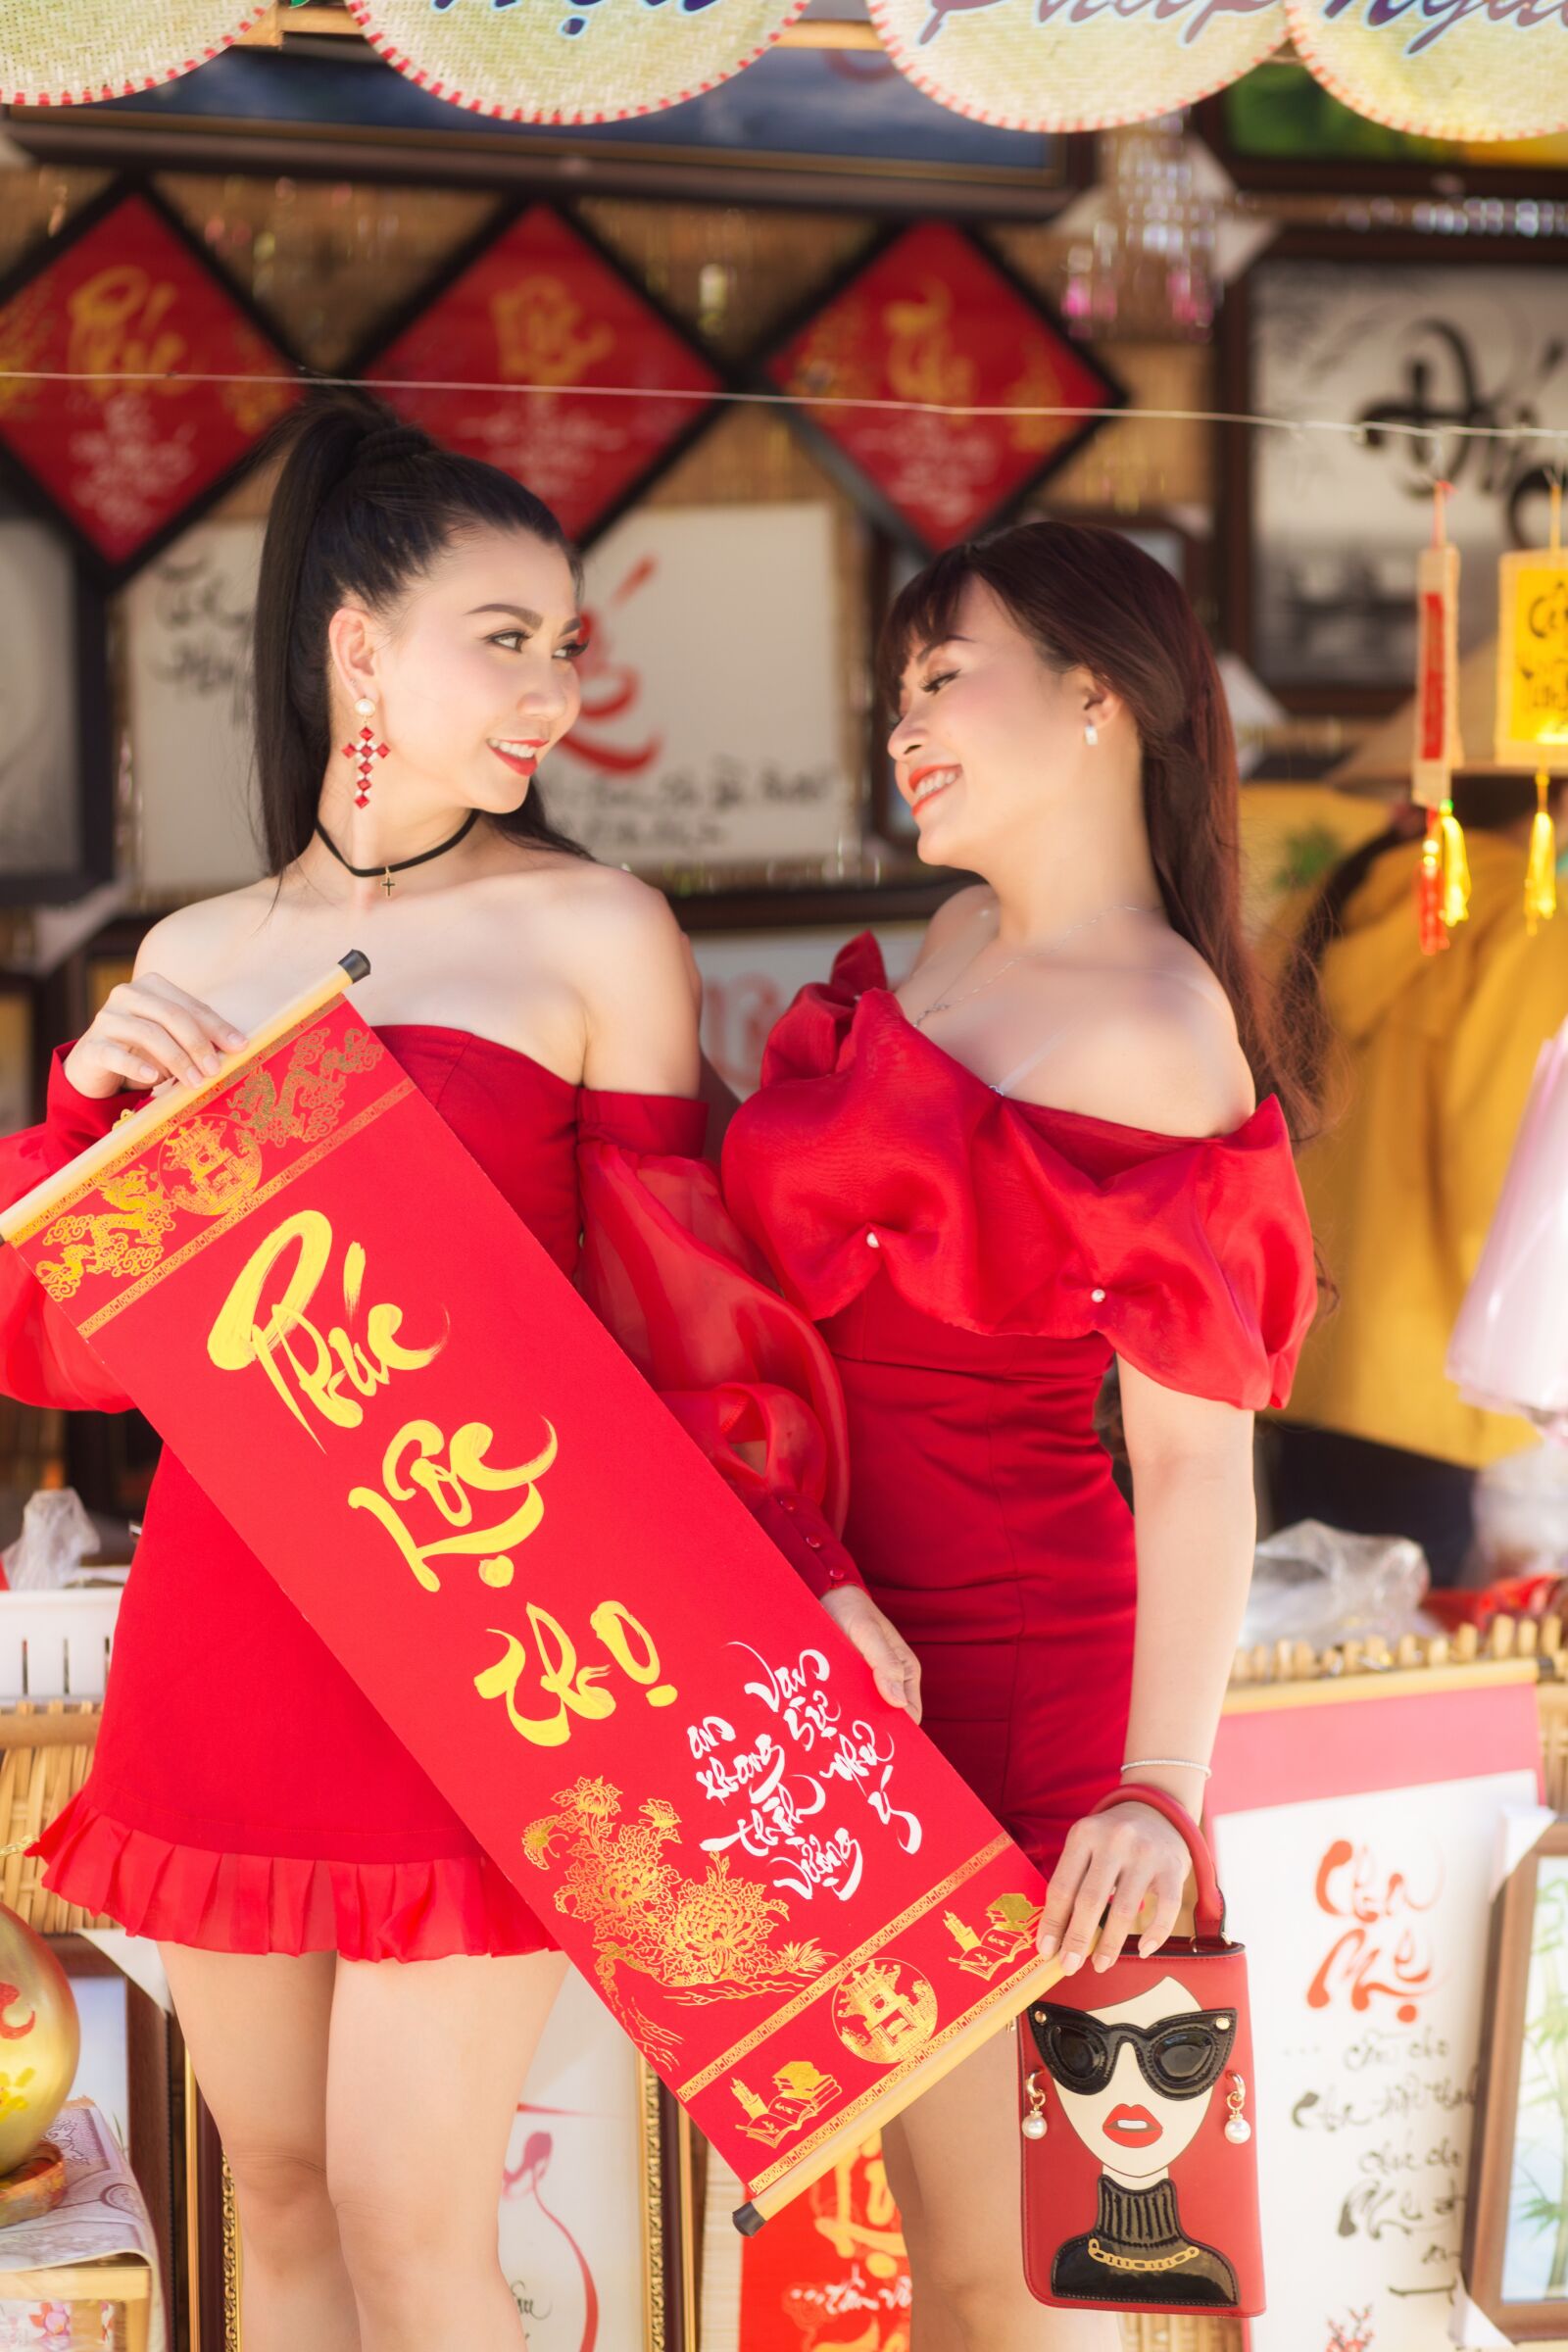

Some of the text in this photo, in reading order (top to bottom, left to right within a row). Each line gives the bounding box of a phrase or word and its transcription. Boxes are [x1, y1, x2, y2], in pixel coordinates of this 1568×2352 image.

[206, 1208, 451, 1455] Phúc
[348, 1413, 559, 1592] Lộc
[473, 1599, 679, 1747] Thọ
[1305, 1927, 1443, 2025] Mẹ
